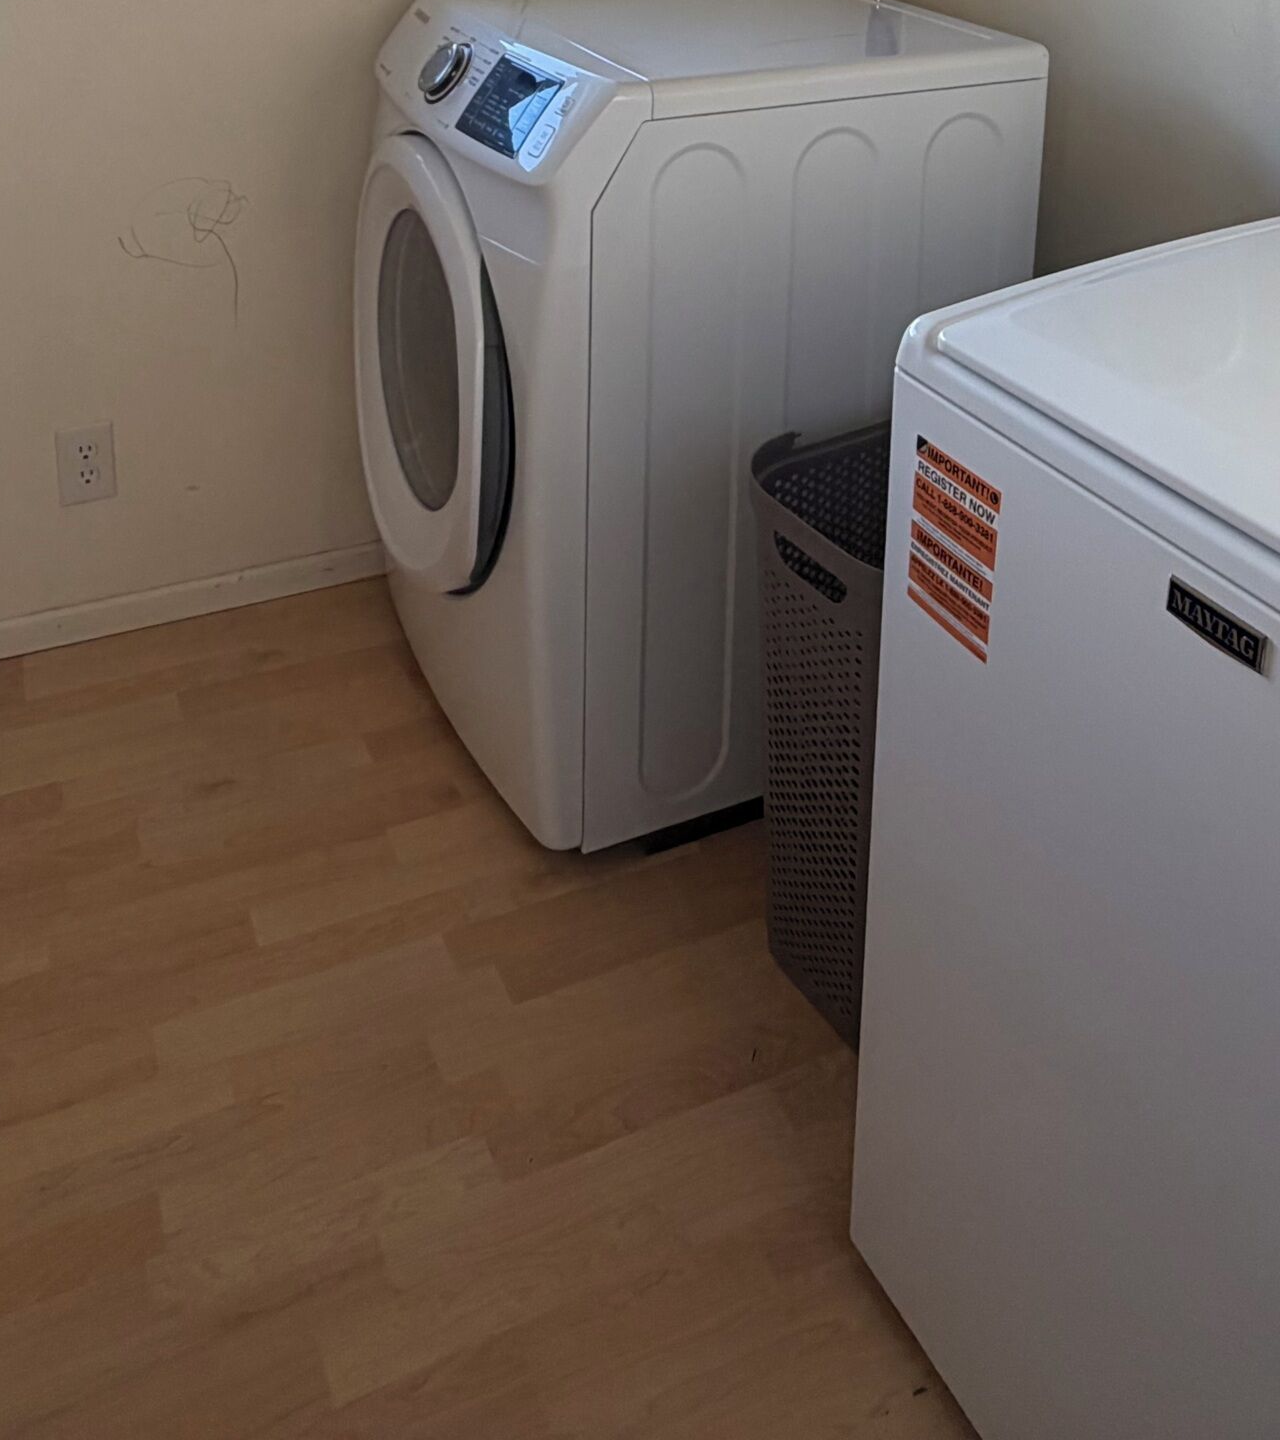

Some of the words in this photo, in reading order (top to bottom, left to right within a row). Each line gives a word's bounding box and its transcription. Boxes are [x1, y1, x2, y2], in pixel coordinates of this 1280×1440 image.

[917, 459, 968, 505] REGISTER
[968, 499, 995, 525] NOW
[927, 445, 989, 499] IMPORTANT!
[1171, 587, 1255, 660] MAYTAG
